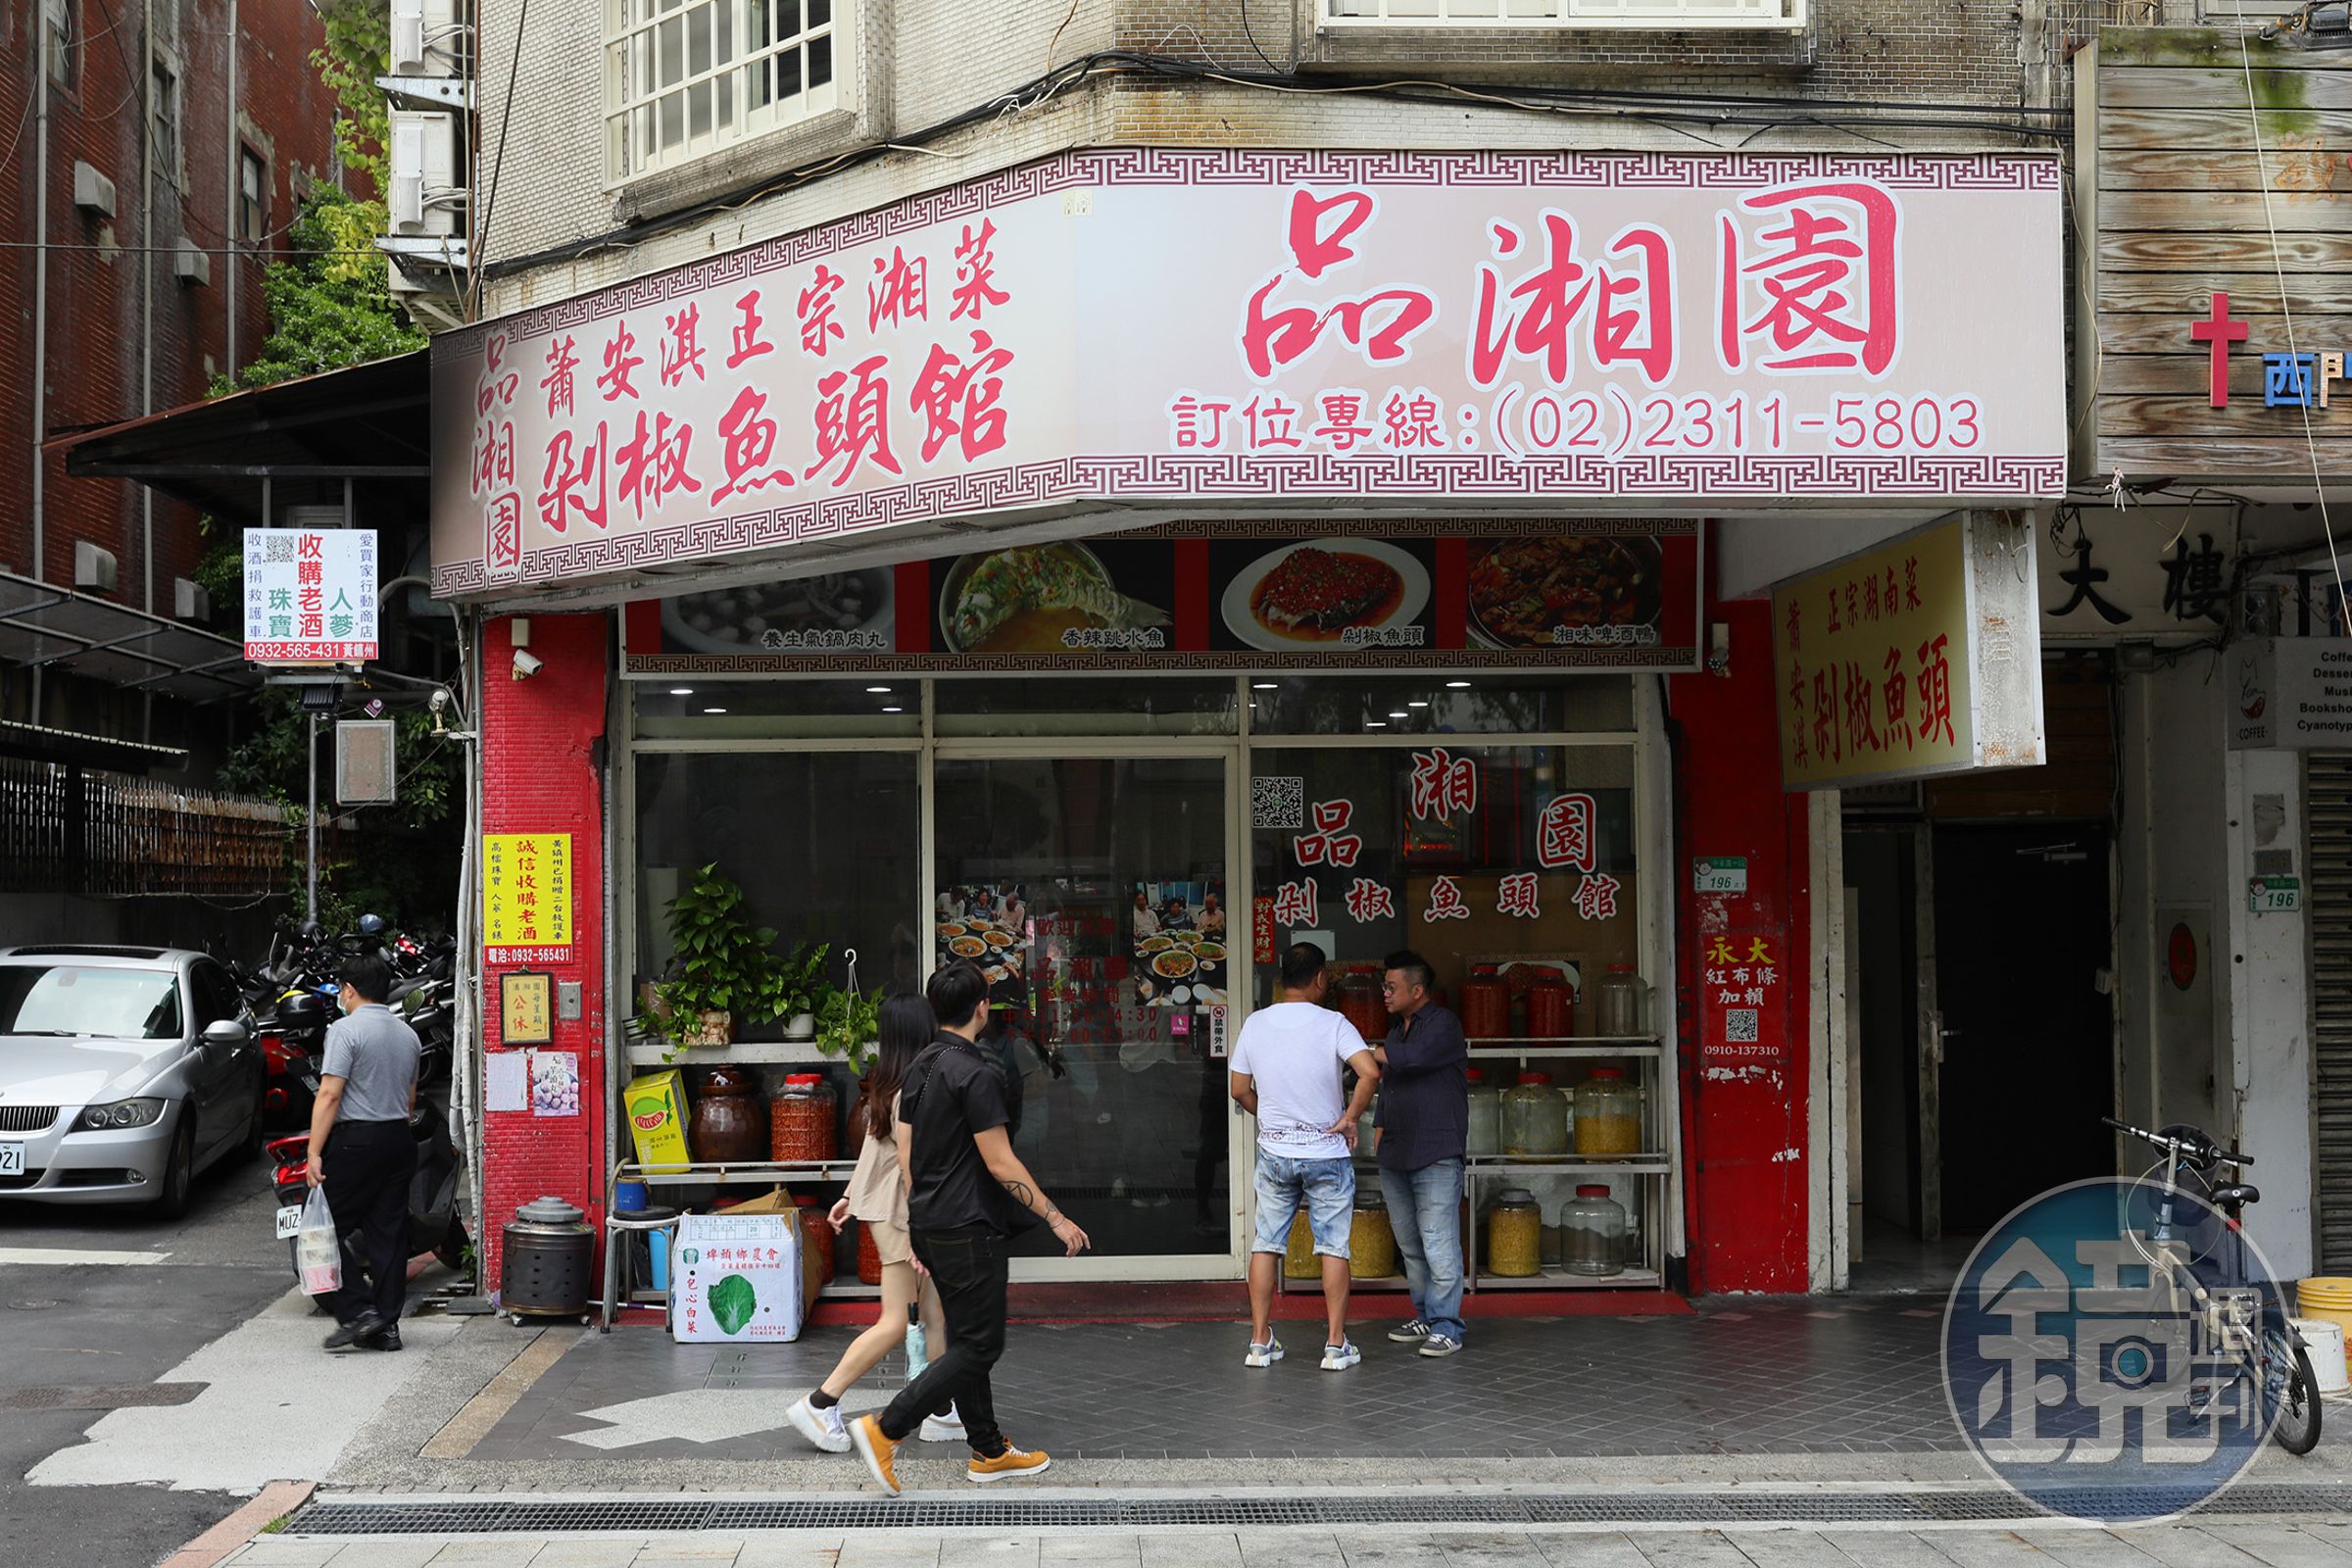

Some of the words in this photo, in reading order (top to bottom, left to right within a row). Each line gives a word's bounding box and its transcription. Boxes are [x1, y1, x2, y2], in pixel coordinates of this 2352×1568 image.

[1241, 183, 1897, 385] 品湘園
[541, 216, 1010, 421] 蕭安淇正宗湘菜
[470, 336, 522, 567] 品湘園
[537, 329, 1015, 534] 剁椒魚頭館
[297, 532, 324, 639] 收購老酒
[1827, 555, 1922, 635] 正宗湖南菜
[269, 587, 293, 639] 珠寶
[1061, 627, 1166, 649] 香辣跳水魚
[1342, 626, 1425, 646] 剁椒魚頭
[1553, 625, 1656, 645] 湘味啤酒鴨
[248, 643, 340, 659] 0932-565-431
[1813, 632, 1955, 764] 剁椒魚頭
[1294, 747, 1596, 873] 品湘園
[515, 839, 539, 941] 誠信收購老酒
[1273, 870, 1621, 928] 剁椒魚頭館
[2268, 893, 2294, 906] 196
[1705, 968, 1780, 986] 紅布條
[1706, 937, 1776, 965] 永大
[513, 995, 529, 1033] 公休
[1704, 1045, 1780, 1056] 0910-137310
[0, 1152, 21, 1170] 21
[686, 1277, 698, 1334] 包心白菜
